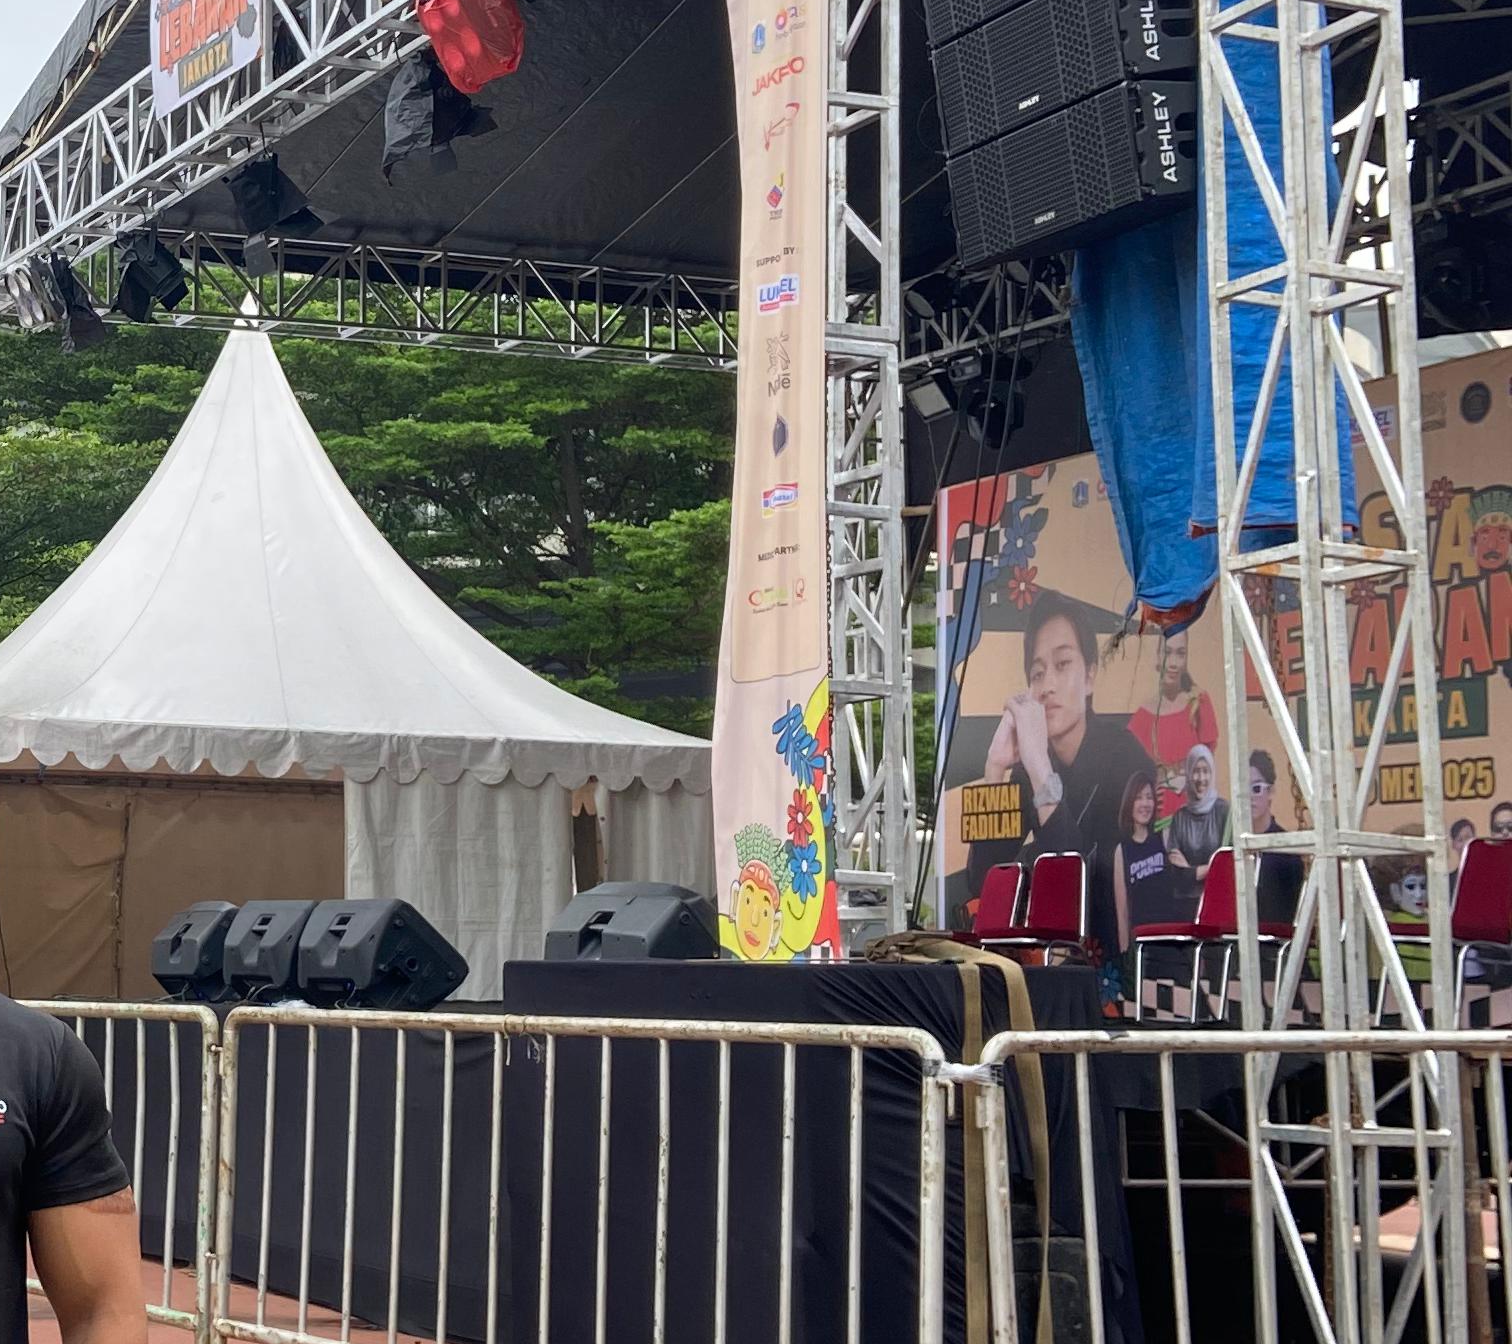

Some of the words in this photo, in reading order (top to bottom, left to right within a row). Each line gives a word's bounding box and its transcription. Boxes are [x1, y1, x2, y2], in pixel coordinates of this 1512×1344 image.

[182, 42, 229, 90] JAKARTA
[1151, 92, 1178, 183] ASHLEY
[963, 783, 1021, 813] RIZWAN
[1443, 758, 1494, 800] 025
[962, 811, 1022, 841] FADILAH
